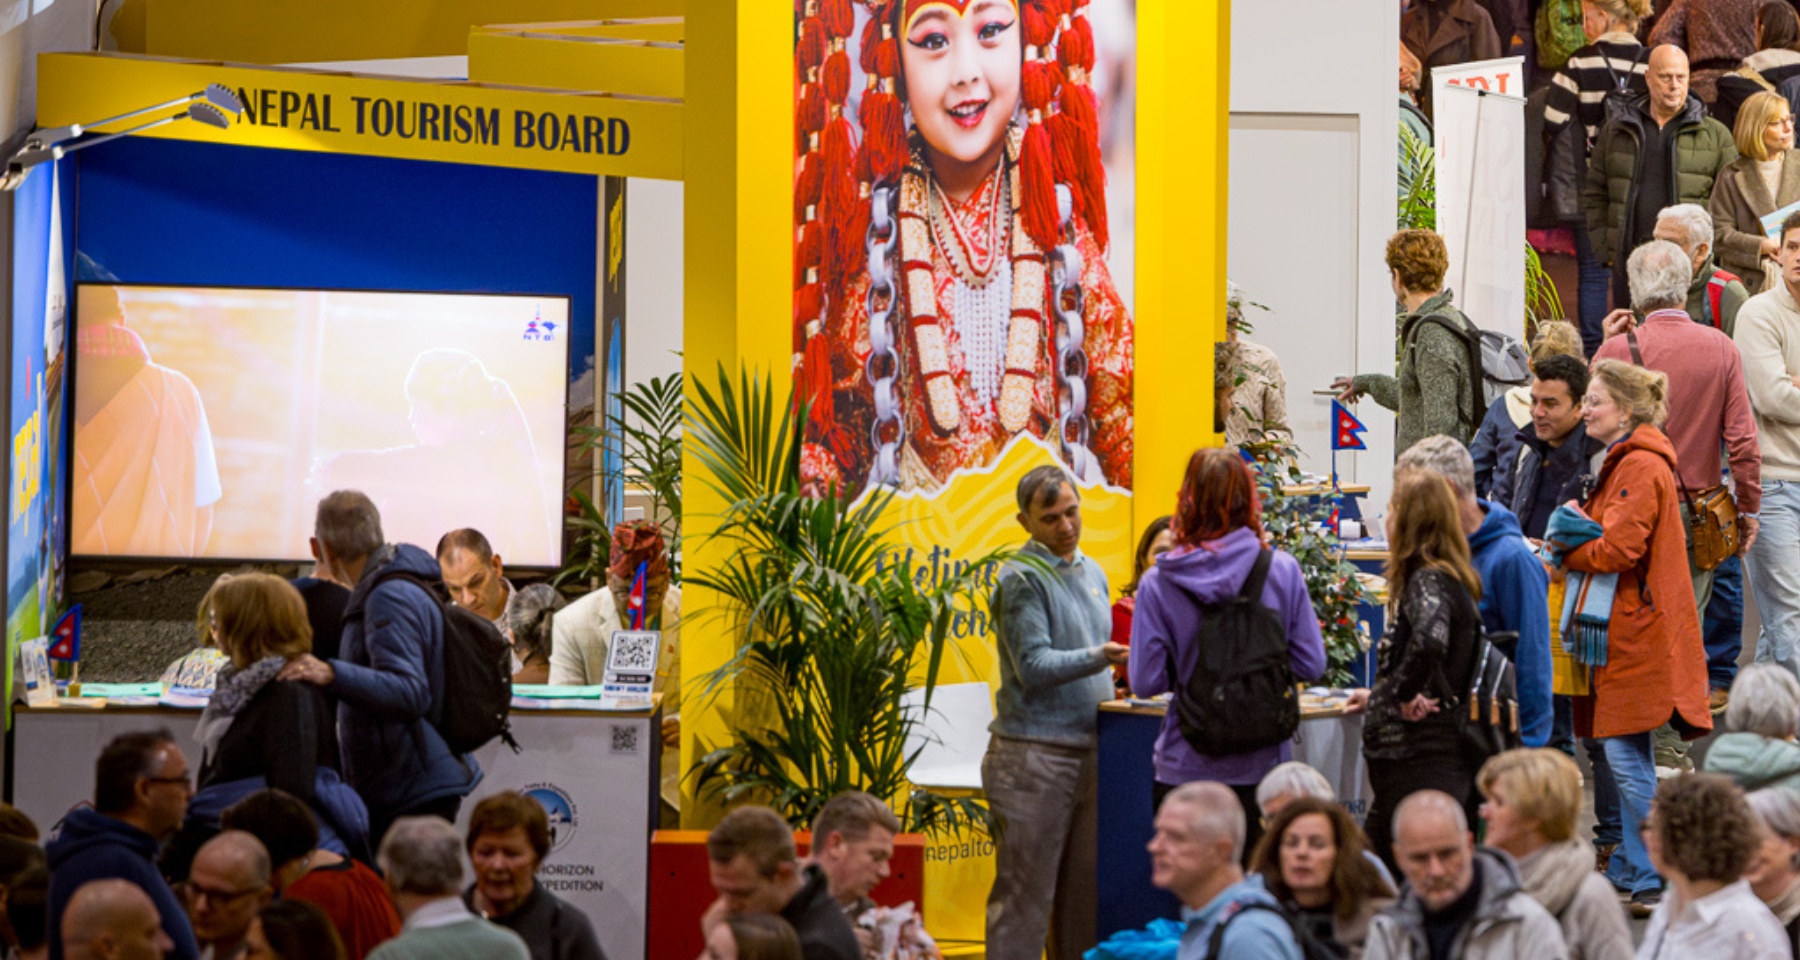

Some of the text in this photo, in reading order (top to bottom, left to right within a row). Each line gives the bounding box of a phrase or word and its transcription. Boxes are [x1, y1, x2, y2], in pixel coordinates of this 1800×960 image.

[237, 87, 630, 156] NEPAL TOURISM BOARD
[925, 839, 994, 865] nepalto
[541, 880, 604, 891] PEDITION
